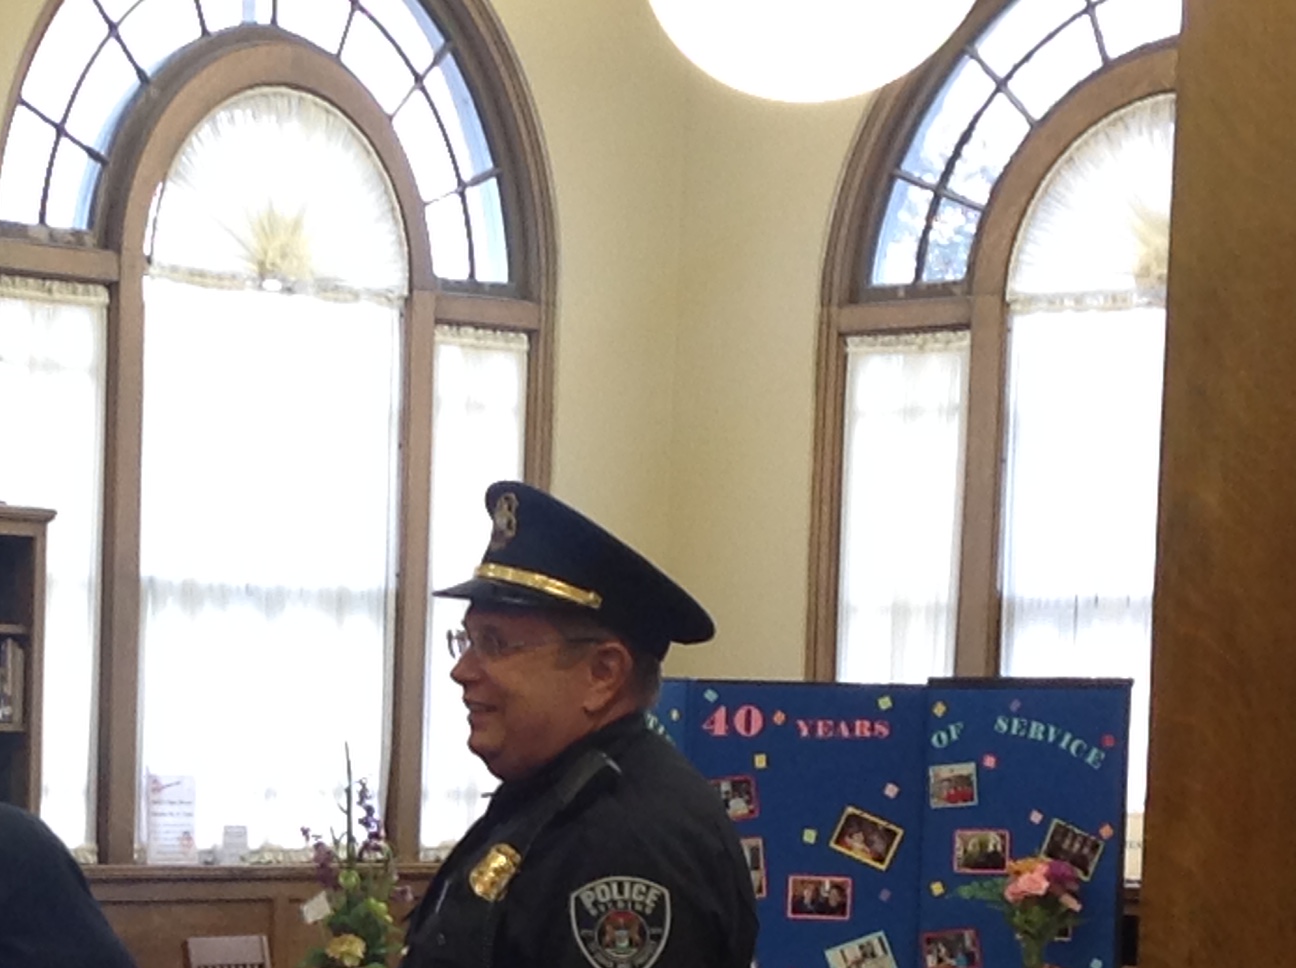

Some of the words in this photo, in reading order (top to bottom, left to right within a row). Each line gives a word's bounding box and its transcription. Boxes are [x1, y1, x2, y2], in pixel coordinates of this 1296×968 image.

[702, 704, 764, 737] 40
[796, 718, 891, 739] YEARS
[930, 721, 965, 749] OF
[993, 714, 1106, 770] SERVICE
[579, 881, 662, 912] POLICE
